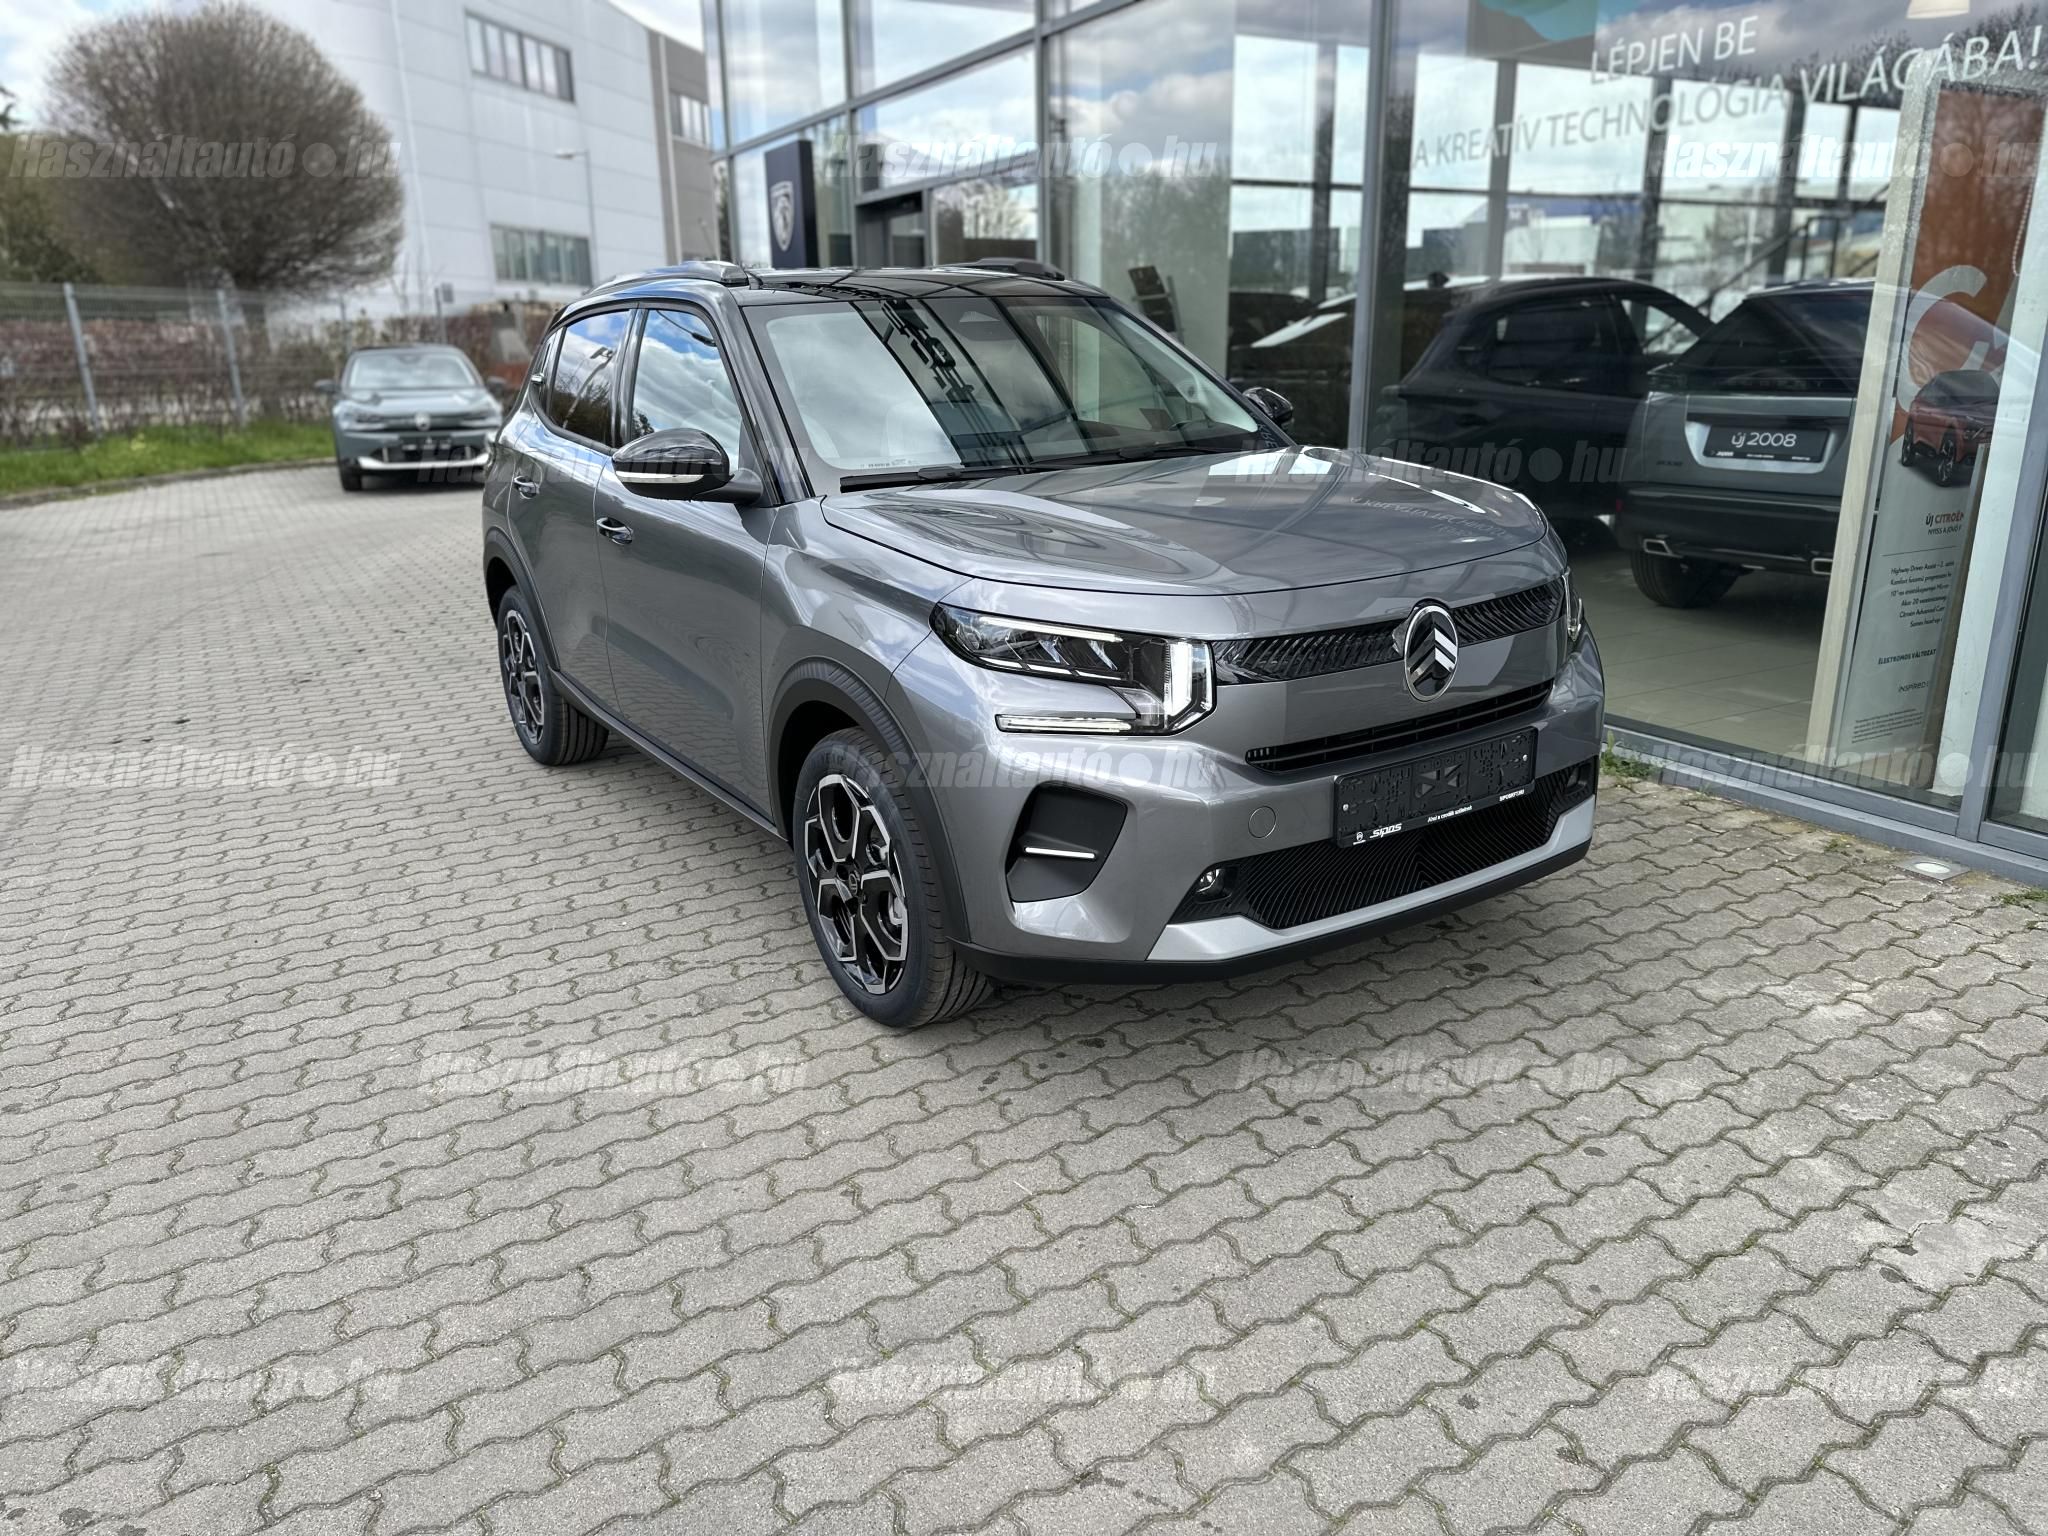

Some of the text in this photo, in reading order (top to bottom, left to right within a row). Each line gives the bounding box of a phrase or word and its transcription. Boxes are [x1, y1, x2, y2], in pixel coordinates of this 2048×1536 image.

[1590, 16, 1758, 85] LÉPJEN BE
[1411, 25, 2042, 170] A KREATÍV TECHNOLÓGIA VILÁGÁBA!
[1731, 432, 1797, 448] új 2008
